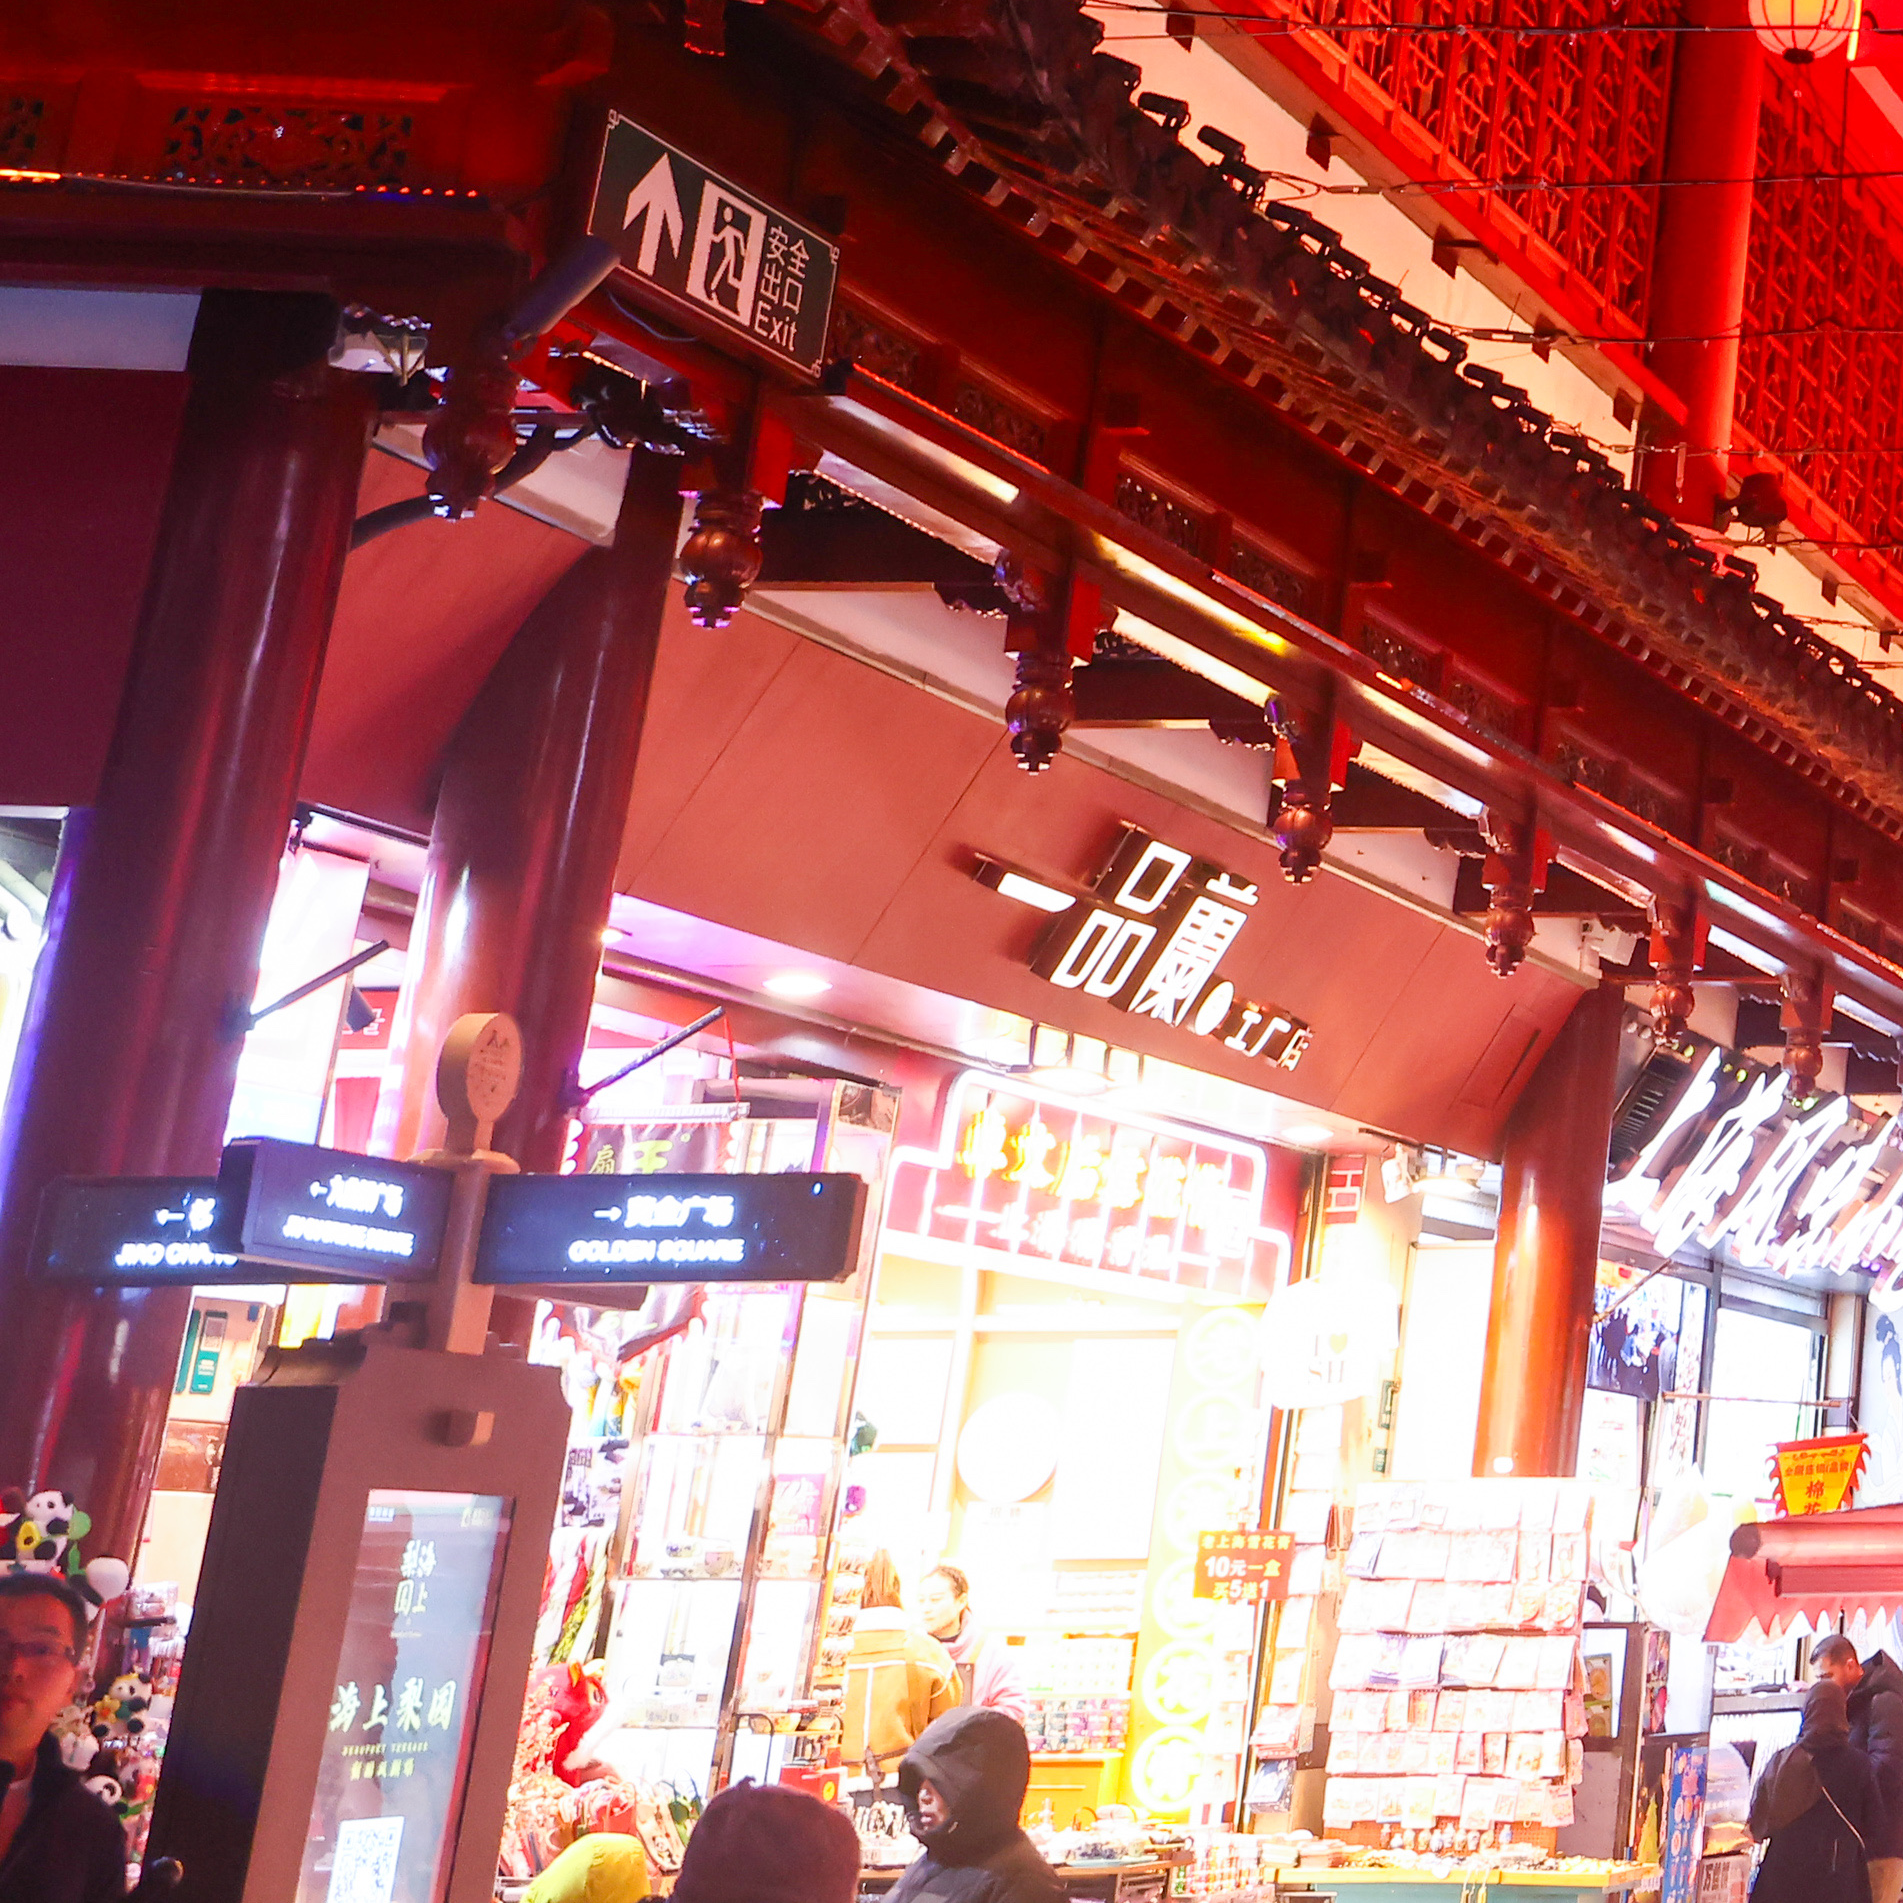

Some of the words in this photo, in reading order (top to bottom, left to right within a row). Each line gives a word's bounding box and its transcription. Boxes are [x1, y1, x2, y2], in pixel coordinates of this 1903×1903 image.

[754, 299, 798, 352] Exit
[1204, 1555, 1283, 1578] 10元一盒
